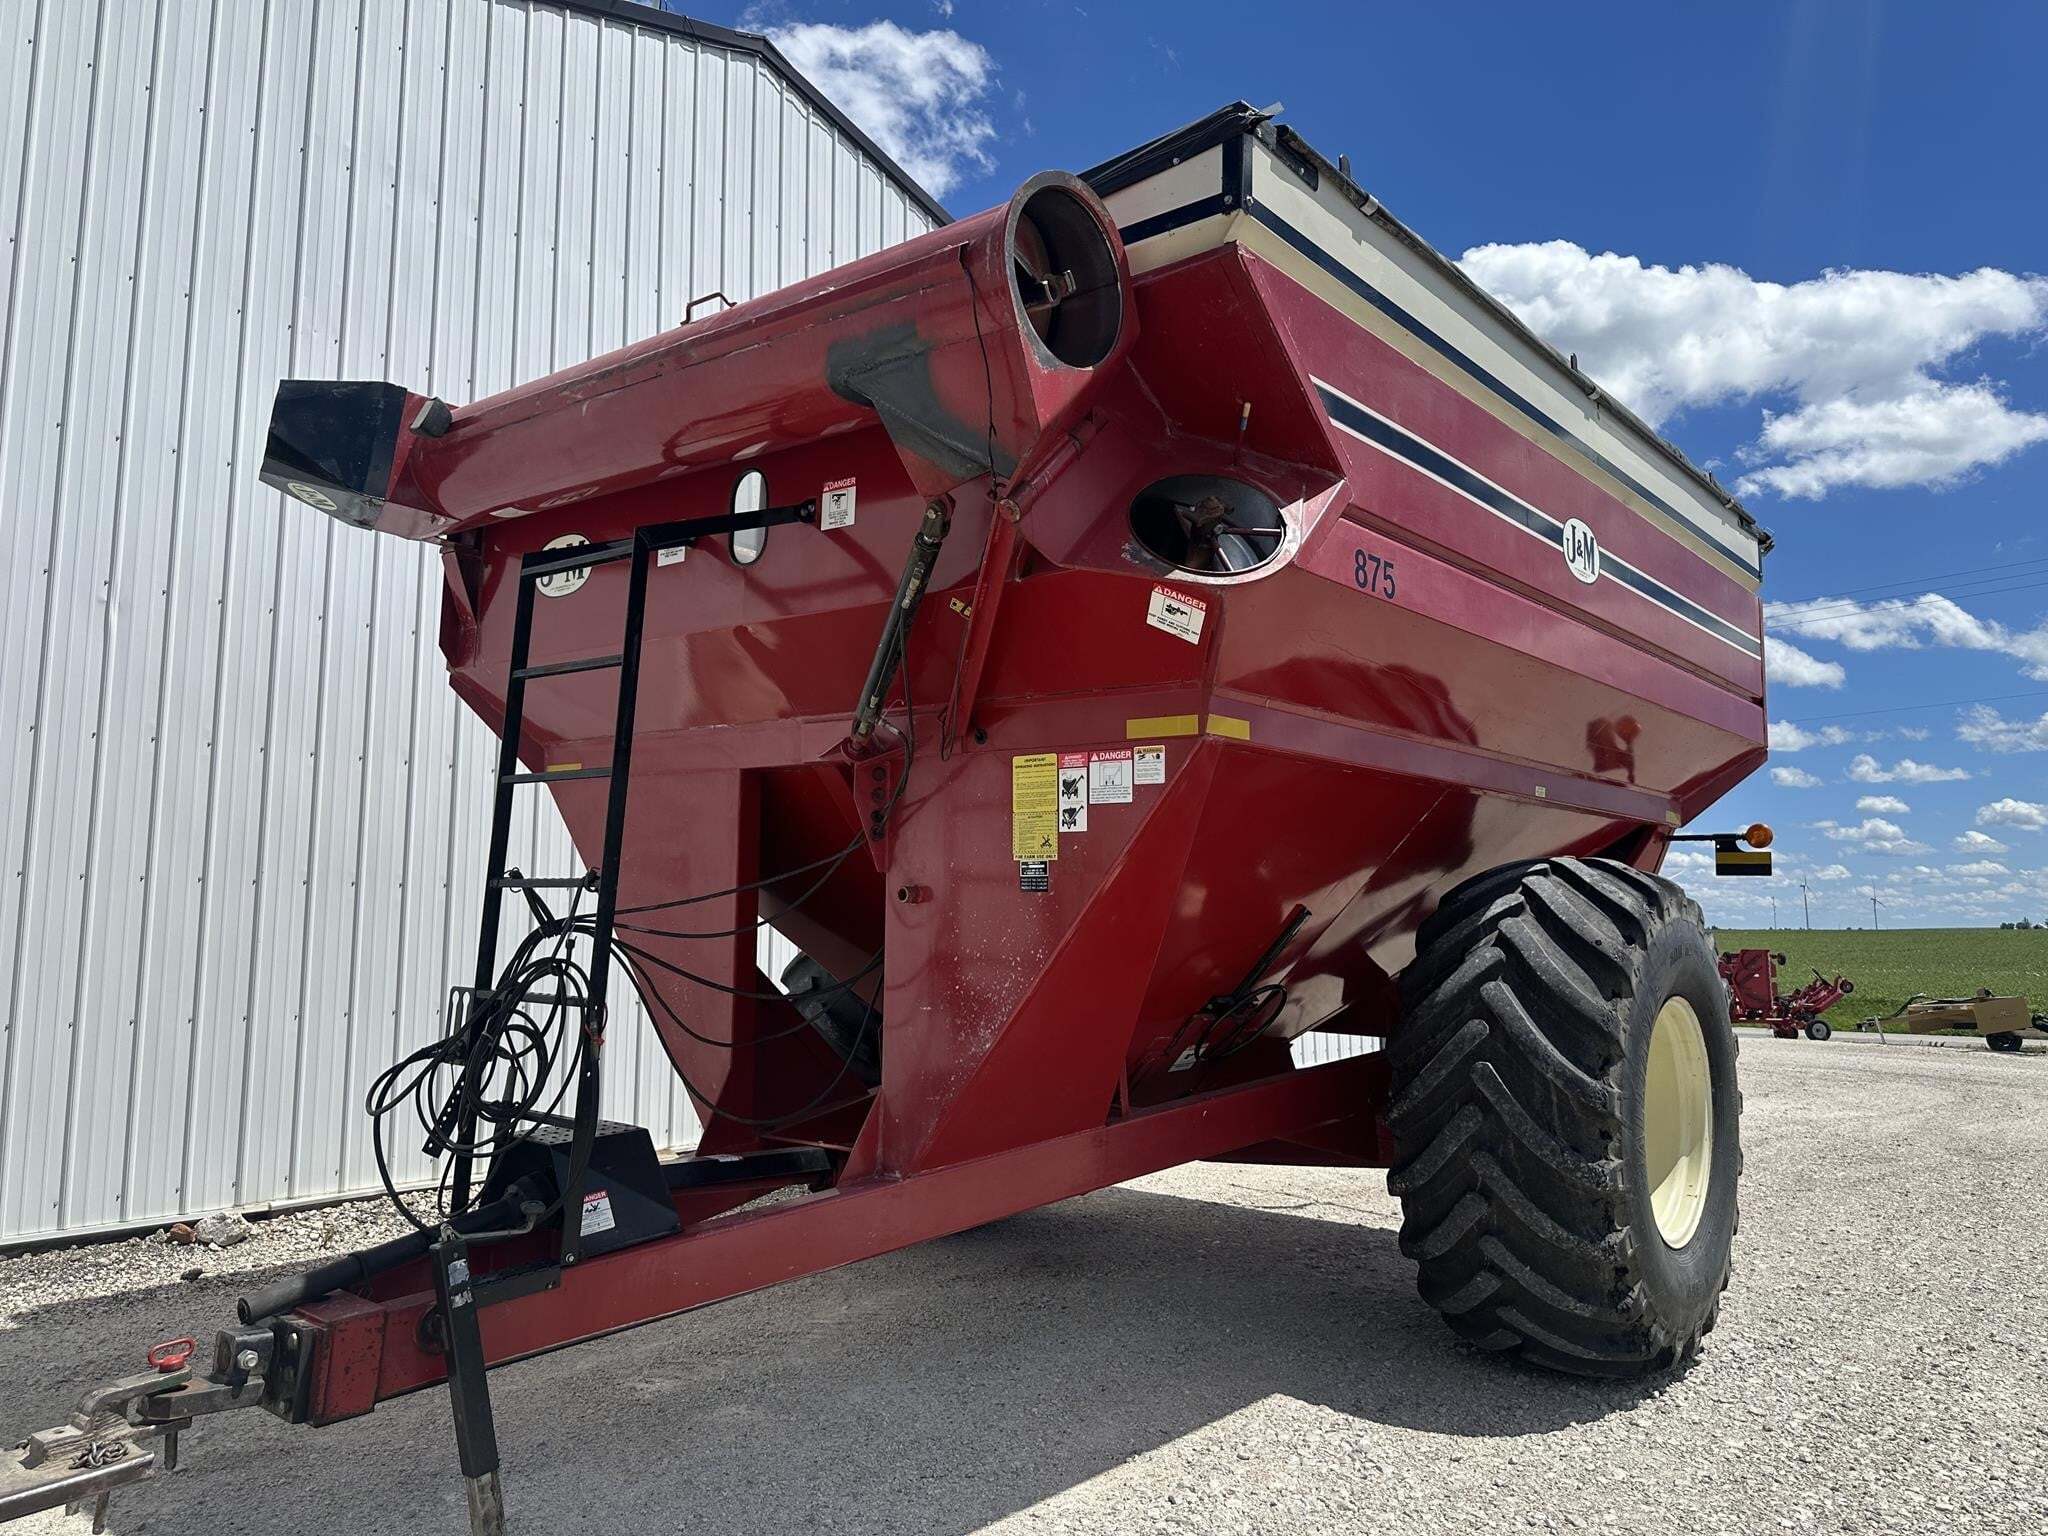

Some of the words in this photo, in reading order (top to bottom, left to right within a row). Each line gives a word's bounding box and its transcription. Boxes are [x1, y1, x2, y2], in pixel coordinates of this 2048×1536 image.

[830, 477, 856, 489] DANGER
[1566, 524, 1596, 576] J&M
[1355, 549, 1396, 599] 875
[1164, 588, 1207, 610] DANGER
[1100, 750, 1131, 760] DANGER
[584, 1191, 606, 1202] ANGER
